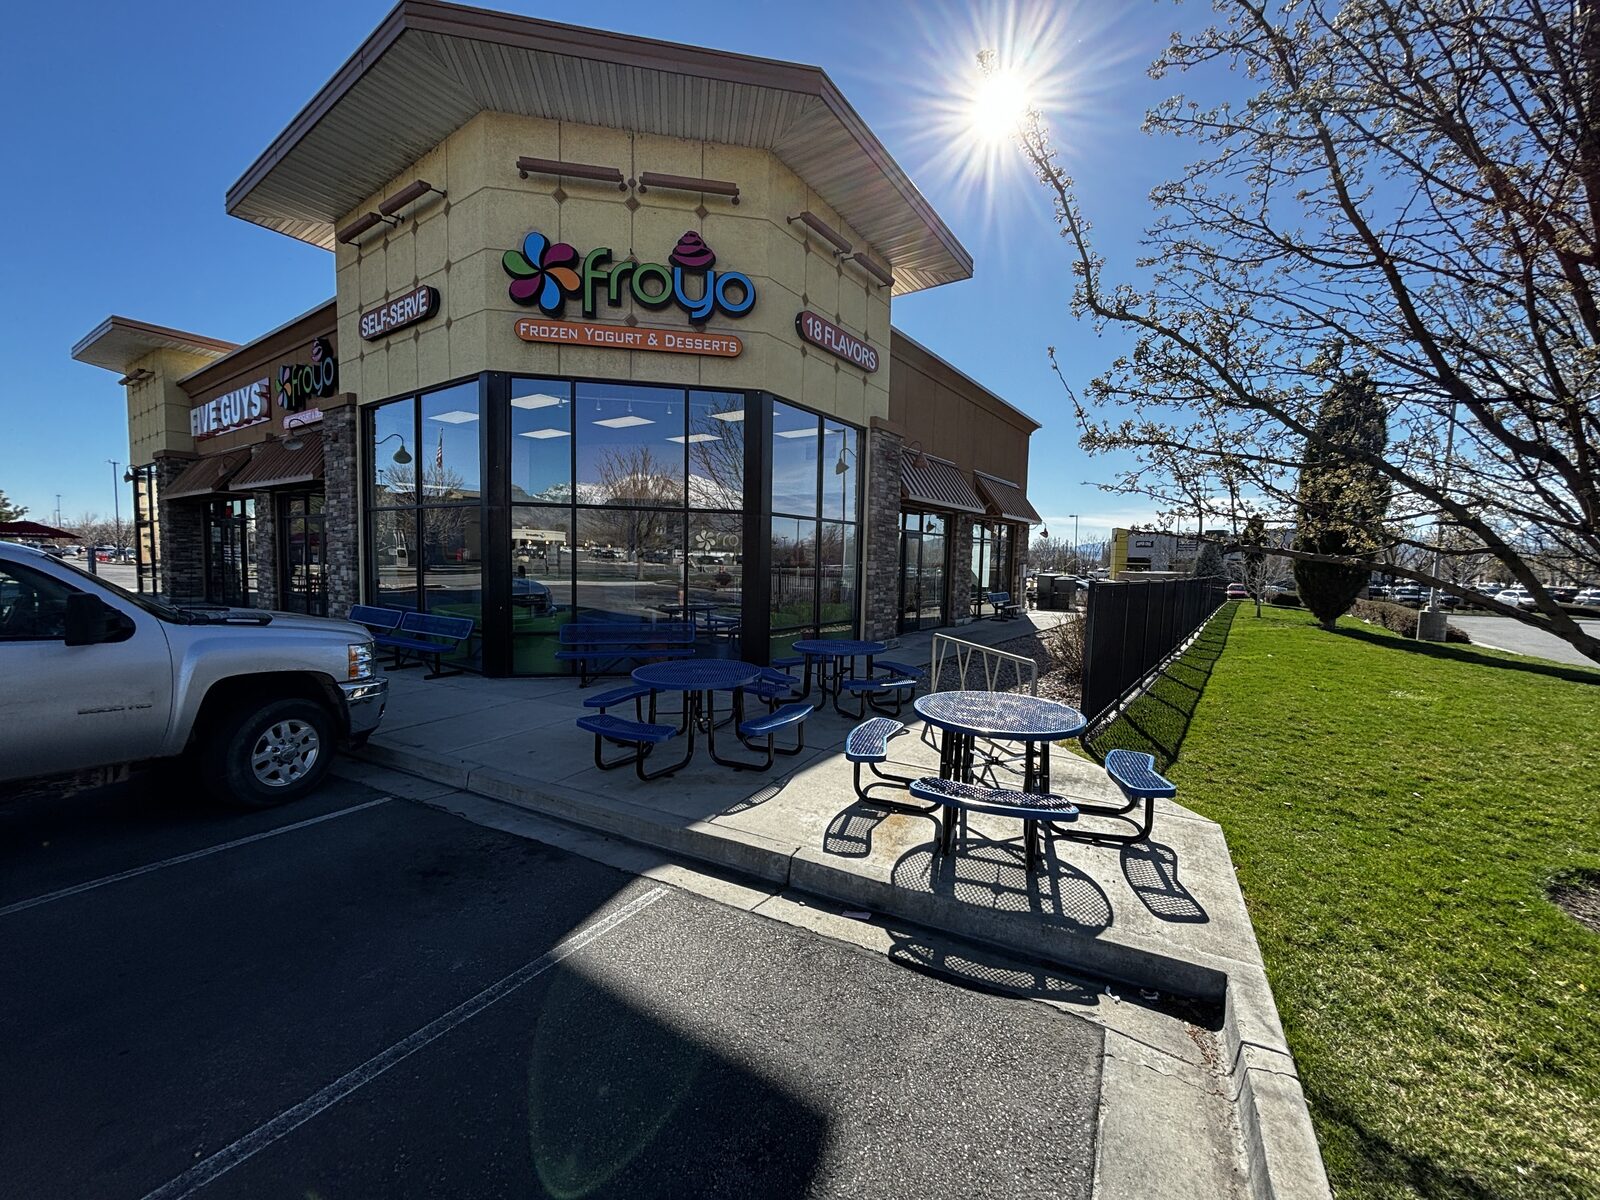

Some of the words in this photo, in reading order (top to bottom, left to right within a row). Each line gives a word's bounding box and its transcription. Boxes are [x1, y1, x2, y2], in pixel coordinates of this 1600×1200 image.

[583, 247, 756, 322] froyo
[361, 289, 428, 337] SELF-SERVE
[647, 333, 658, 346] &
[806, 317, 822, 341] 18
[824, 326, 876, 370] FLAVORS
[291, 357, 334, 407] froyo
[190, 400, 218, 437] FIVE
[220, 382, 261, 427] GUYS
